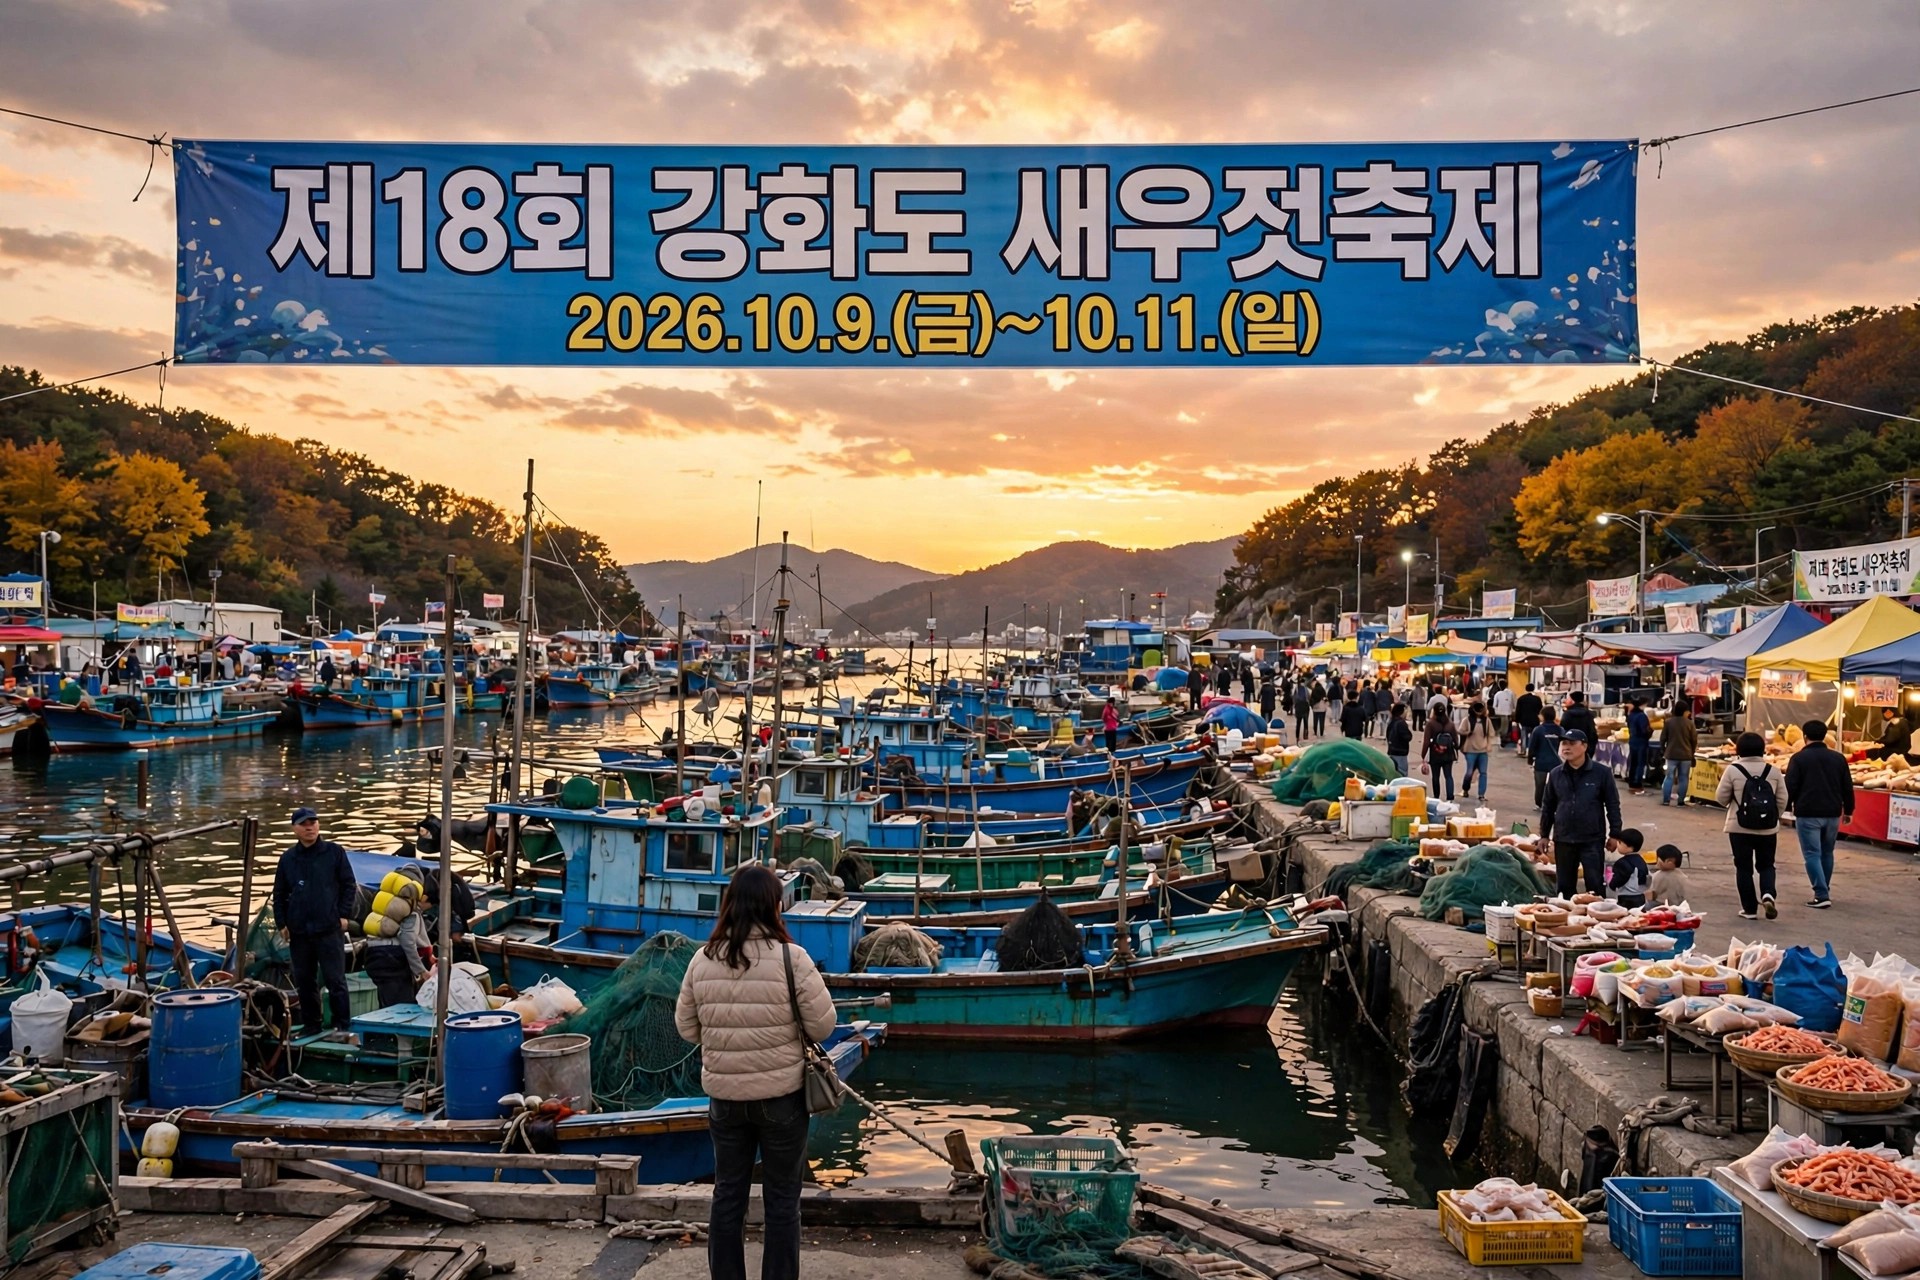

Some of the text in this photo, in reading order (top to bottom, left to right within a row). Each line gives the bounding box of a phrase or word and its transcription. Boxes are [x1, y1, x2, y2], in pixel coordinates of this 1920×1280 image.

[267, 160, 1542, 282] 제18회 강화도 새우젓축제
[566, 289, 1321, 357] 2026.10.9.(금)~10.11.(일)
